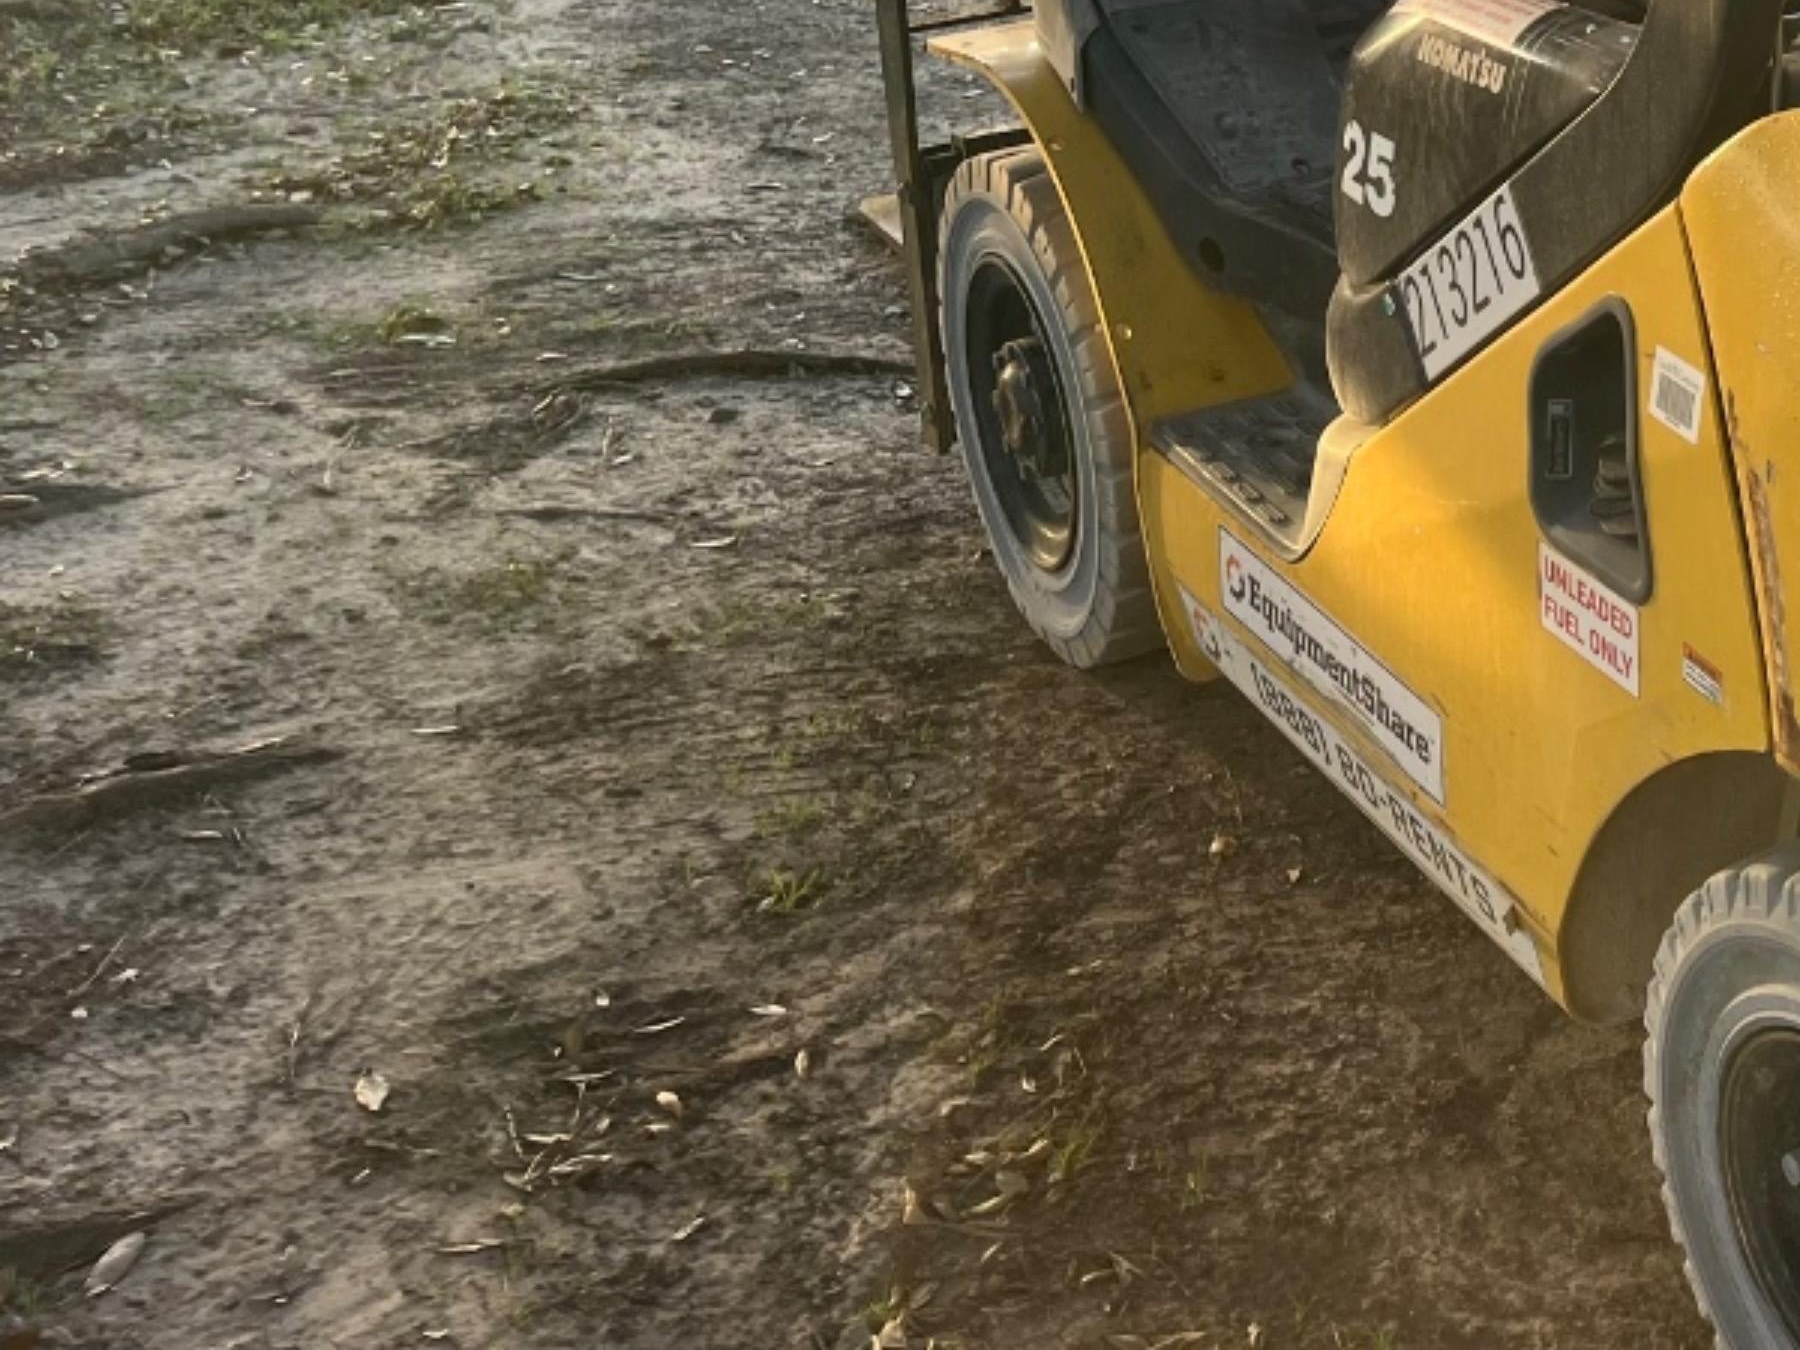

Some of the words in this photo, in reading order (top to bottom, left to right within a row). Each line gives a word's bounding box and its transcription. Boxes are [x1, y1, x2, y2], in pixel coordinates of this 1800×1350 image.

[1418, 31, 1507, 94] KOMATSU
[1341, 119, 1396, 218] 25
[1403, 192, 1526, 358] 213216
[1544, 554, 1633, 640] UNLEADED
[1544, 594, 1585, 646] FUEL
[1590, 629, 1634, 680] ONLY
[1247, 574, 1432, 765] EquipmentShare
